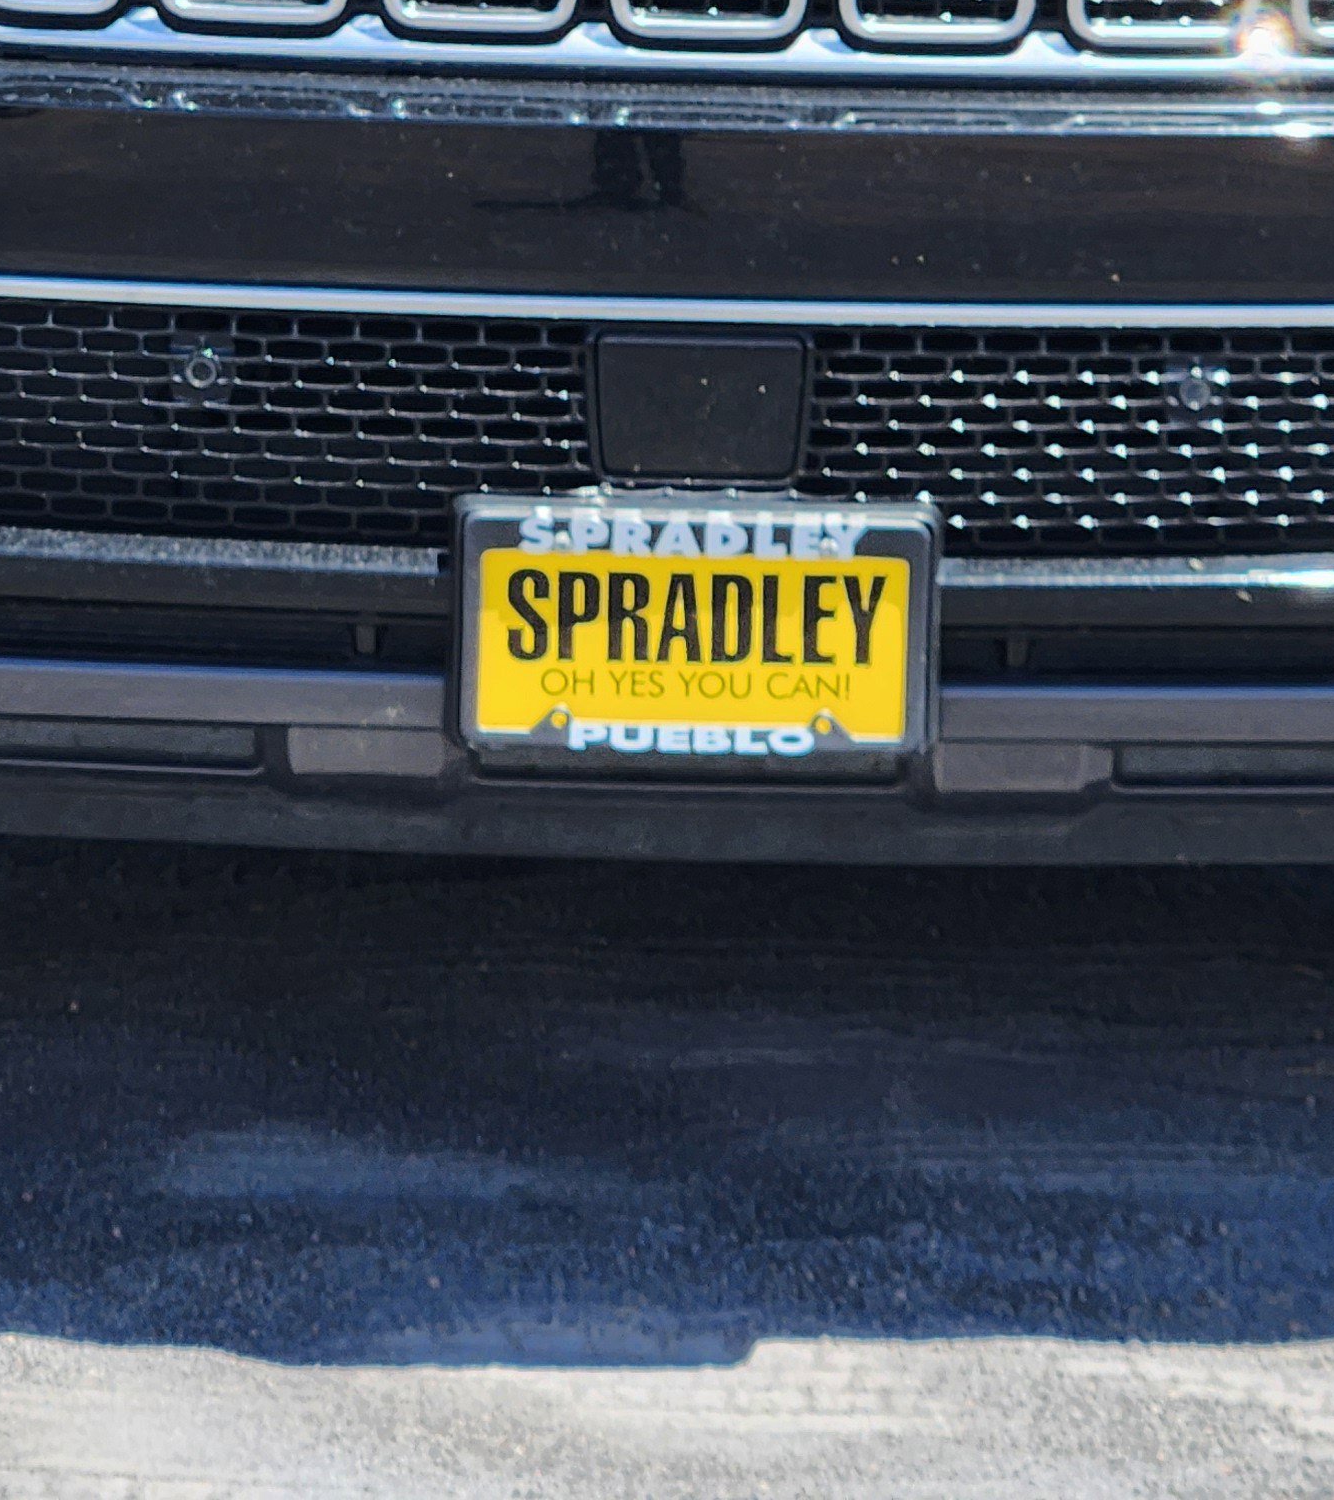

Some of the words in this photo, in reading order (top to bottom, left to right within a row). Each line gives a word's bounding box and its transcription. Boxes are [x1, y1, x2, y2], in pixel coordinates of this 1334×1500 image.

[518, 506, 867, 559] SPRADLEY
[506, 568, 888, 665] SPRADLEY
[540, 668, 595, 696] OH
[608, 670, 665, 698] YES
[678, 671, 752, 699] YOU
[766, 672, 851, 700] CAN!
[567, 720, 816, 756] PUEBLO
